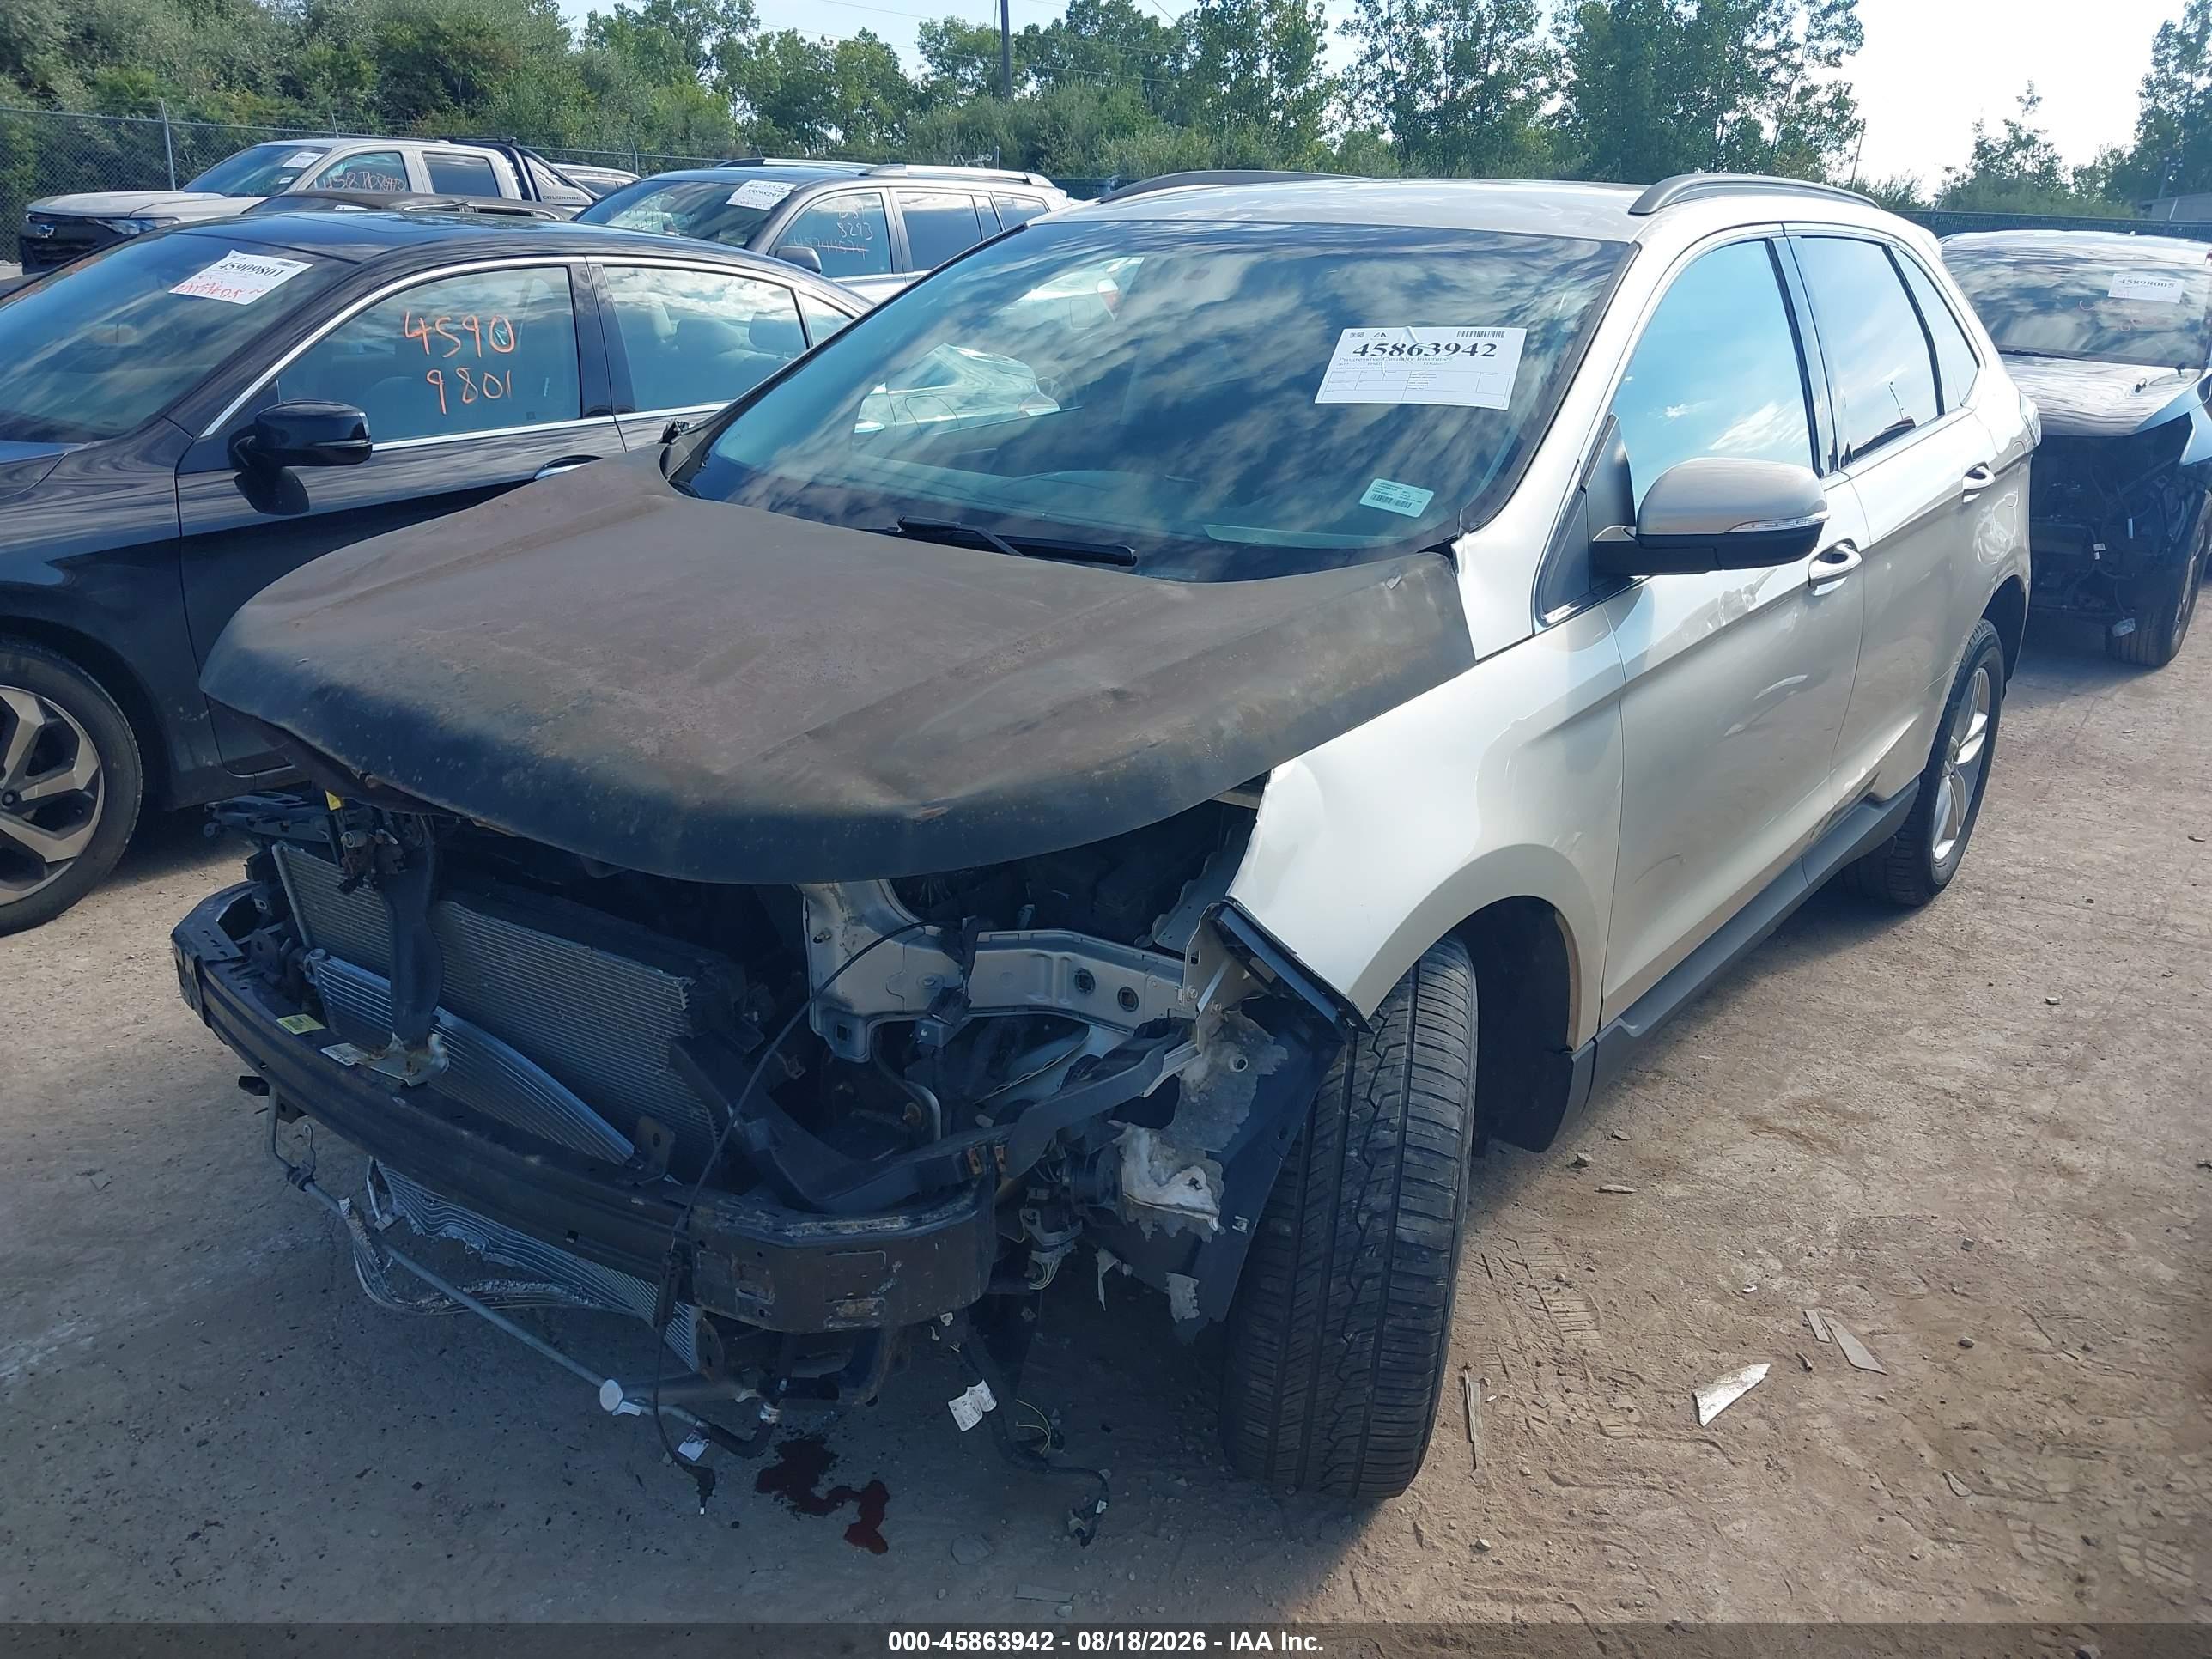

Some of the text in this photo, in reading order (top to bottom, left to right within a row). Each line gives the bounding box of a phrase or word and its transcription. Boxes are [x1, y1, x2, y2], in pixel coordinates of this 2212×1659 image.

[219, 261, 286, 278] 45909801
[404, 311, 515, 358] 4590
[1352, 342, 1498, 357] 45863942
[426, 367, 513, 415] 9801
